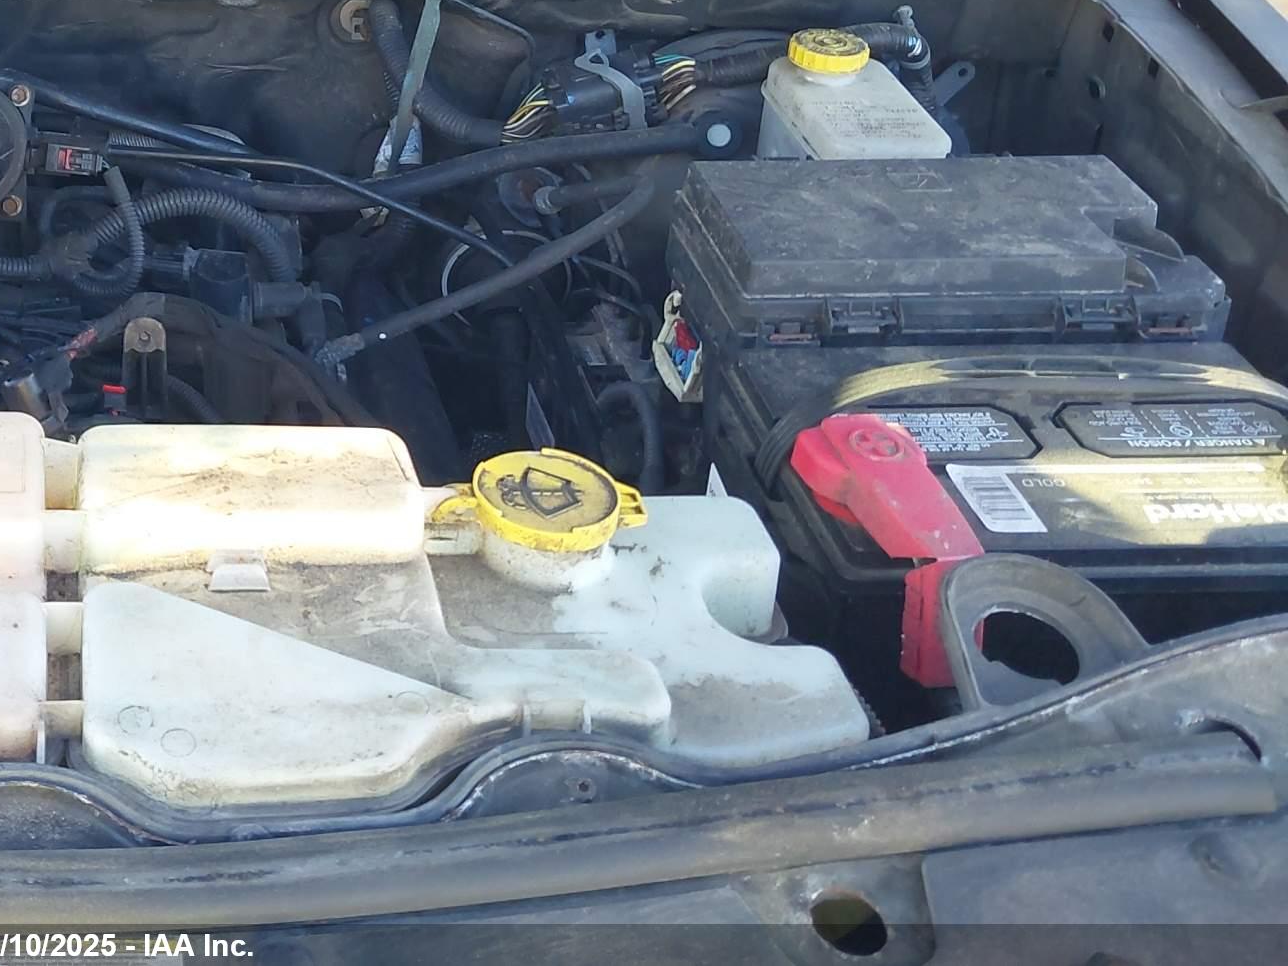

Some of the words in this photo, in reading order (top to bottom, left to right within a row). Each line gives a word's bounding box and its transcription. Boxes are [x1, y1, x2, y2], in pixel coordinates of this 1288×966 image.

[1127, 438, 1182, 448] POISON
[1193, 438, 1253, 448] DANGER
[1021, 478, 1066, 488] GOLD
[1144, 503, 1288, 524] DieHard
